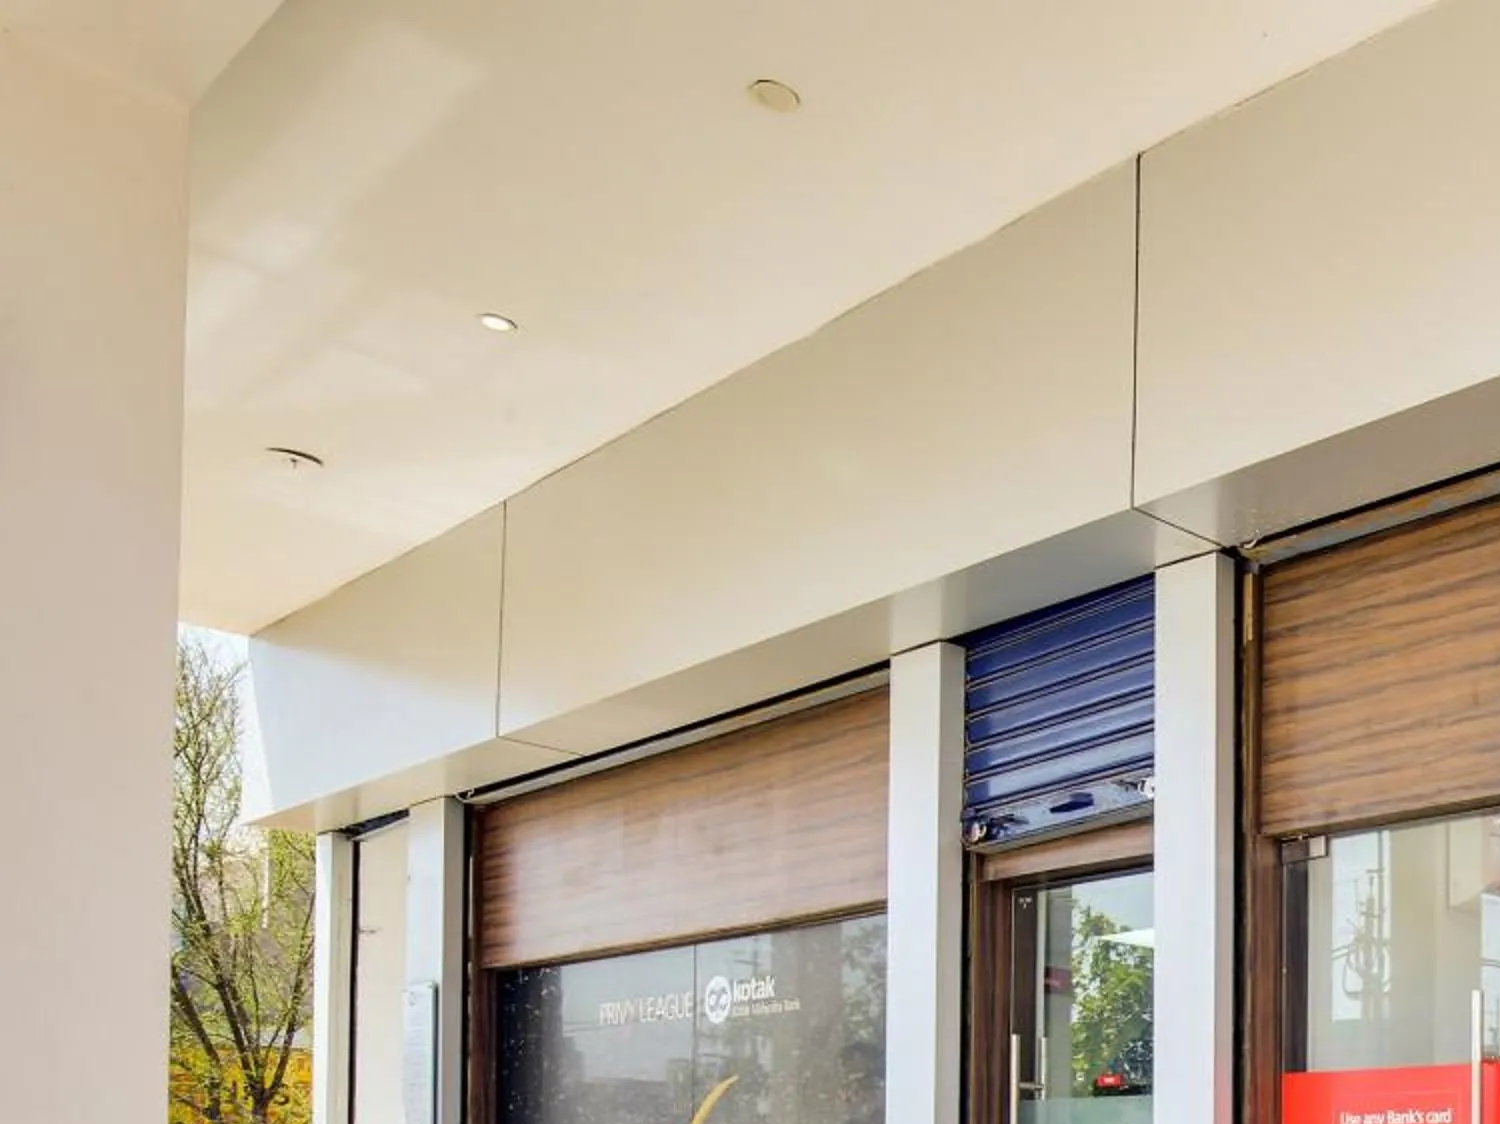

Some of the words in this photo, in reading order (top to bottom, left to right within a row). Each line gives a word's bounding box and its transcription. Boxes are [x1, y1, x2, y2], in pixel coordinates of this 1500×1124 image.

[733, 976, 776, 1002] kotak
[638, 991, 694, 1024] LEAGUE
[1387, 1108, 1424, 1124] Bank's
[1426, 1107, 1453, 1124] card
